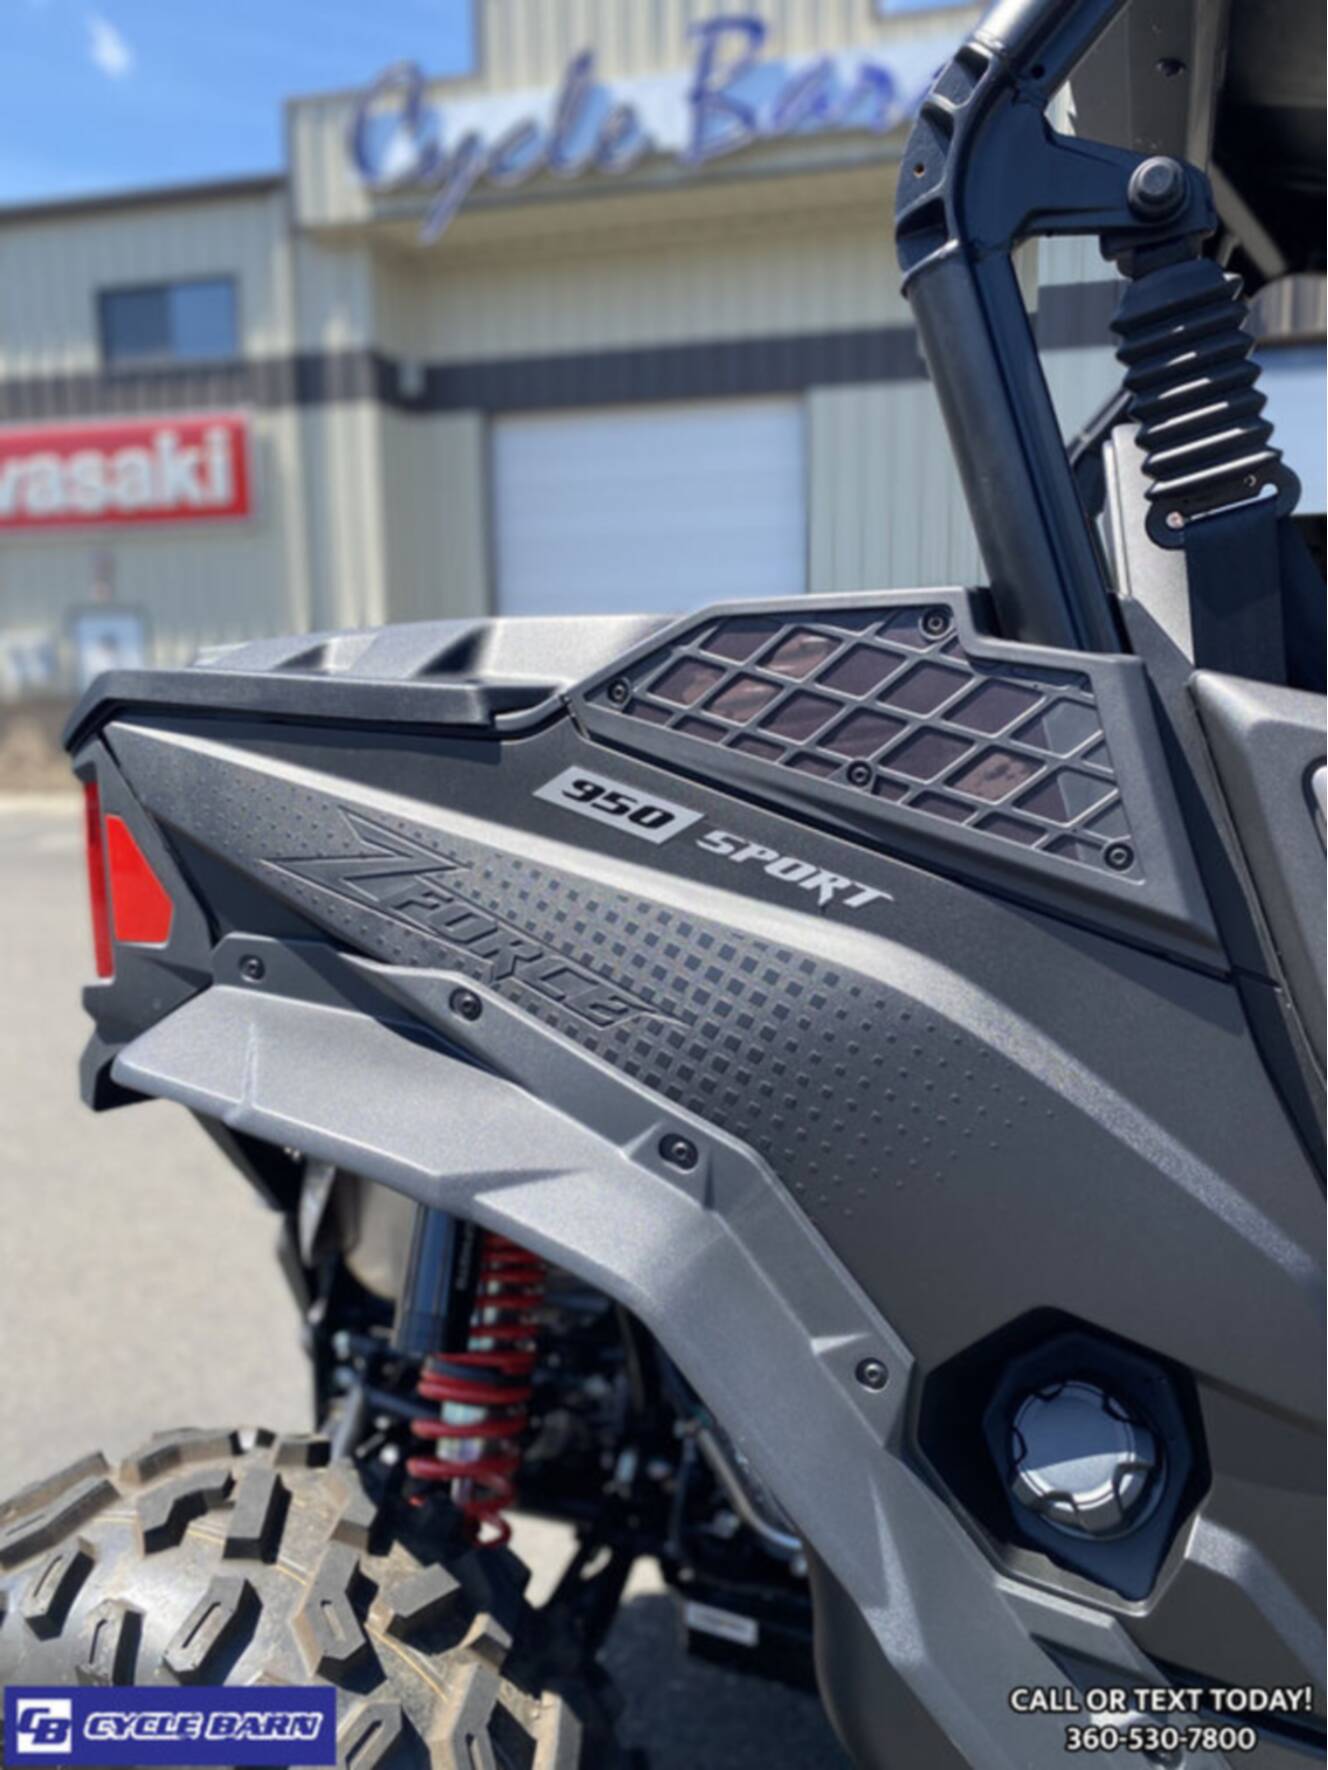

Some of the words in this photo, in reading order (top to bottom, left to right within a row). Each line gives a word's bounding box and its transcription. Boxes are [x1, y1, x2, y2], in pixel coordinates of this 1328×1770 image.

[350, 50, 653, 245] Cycle
[682, 14, 945, 168] Bar
[562, 779, 676, 829] 950
[696, 830, 894, 908] SPORT
